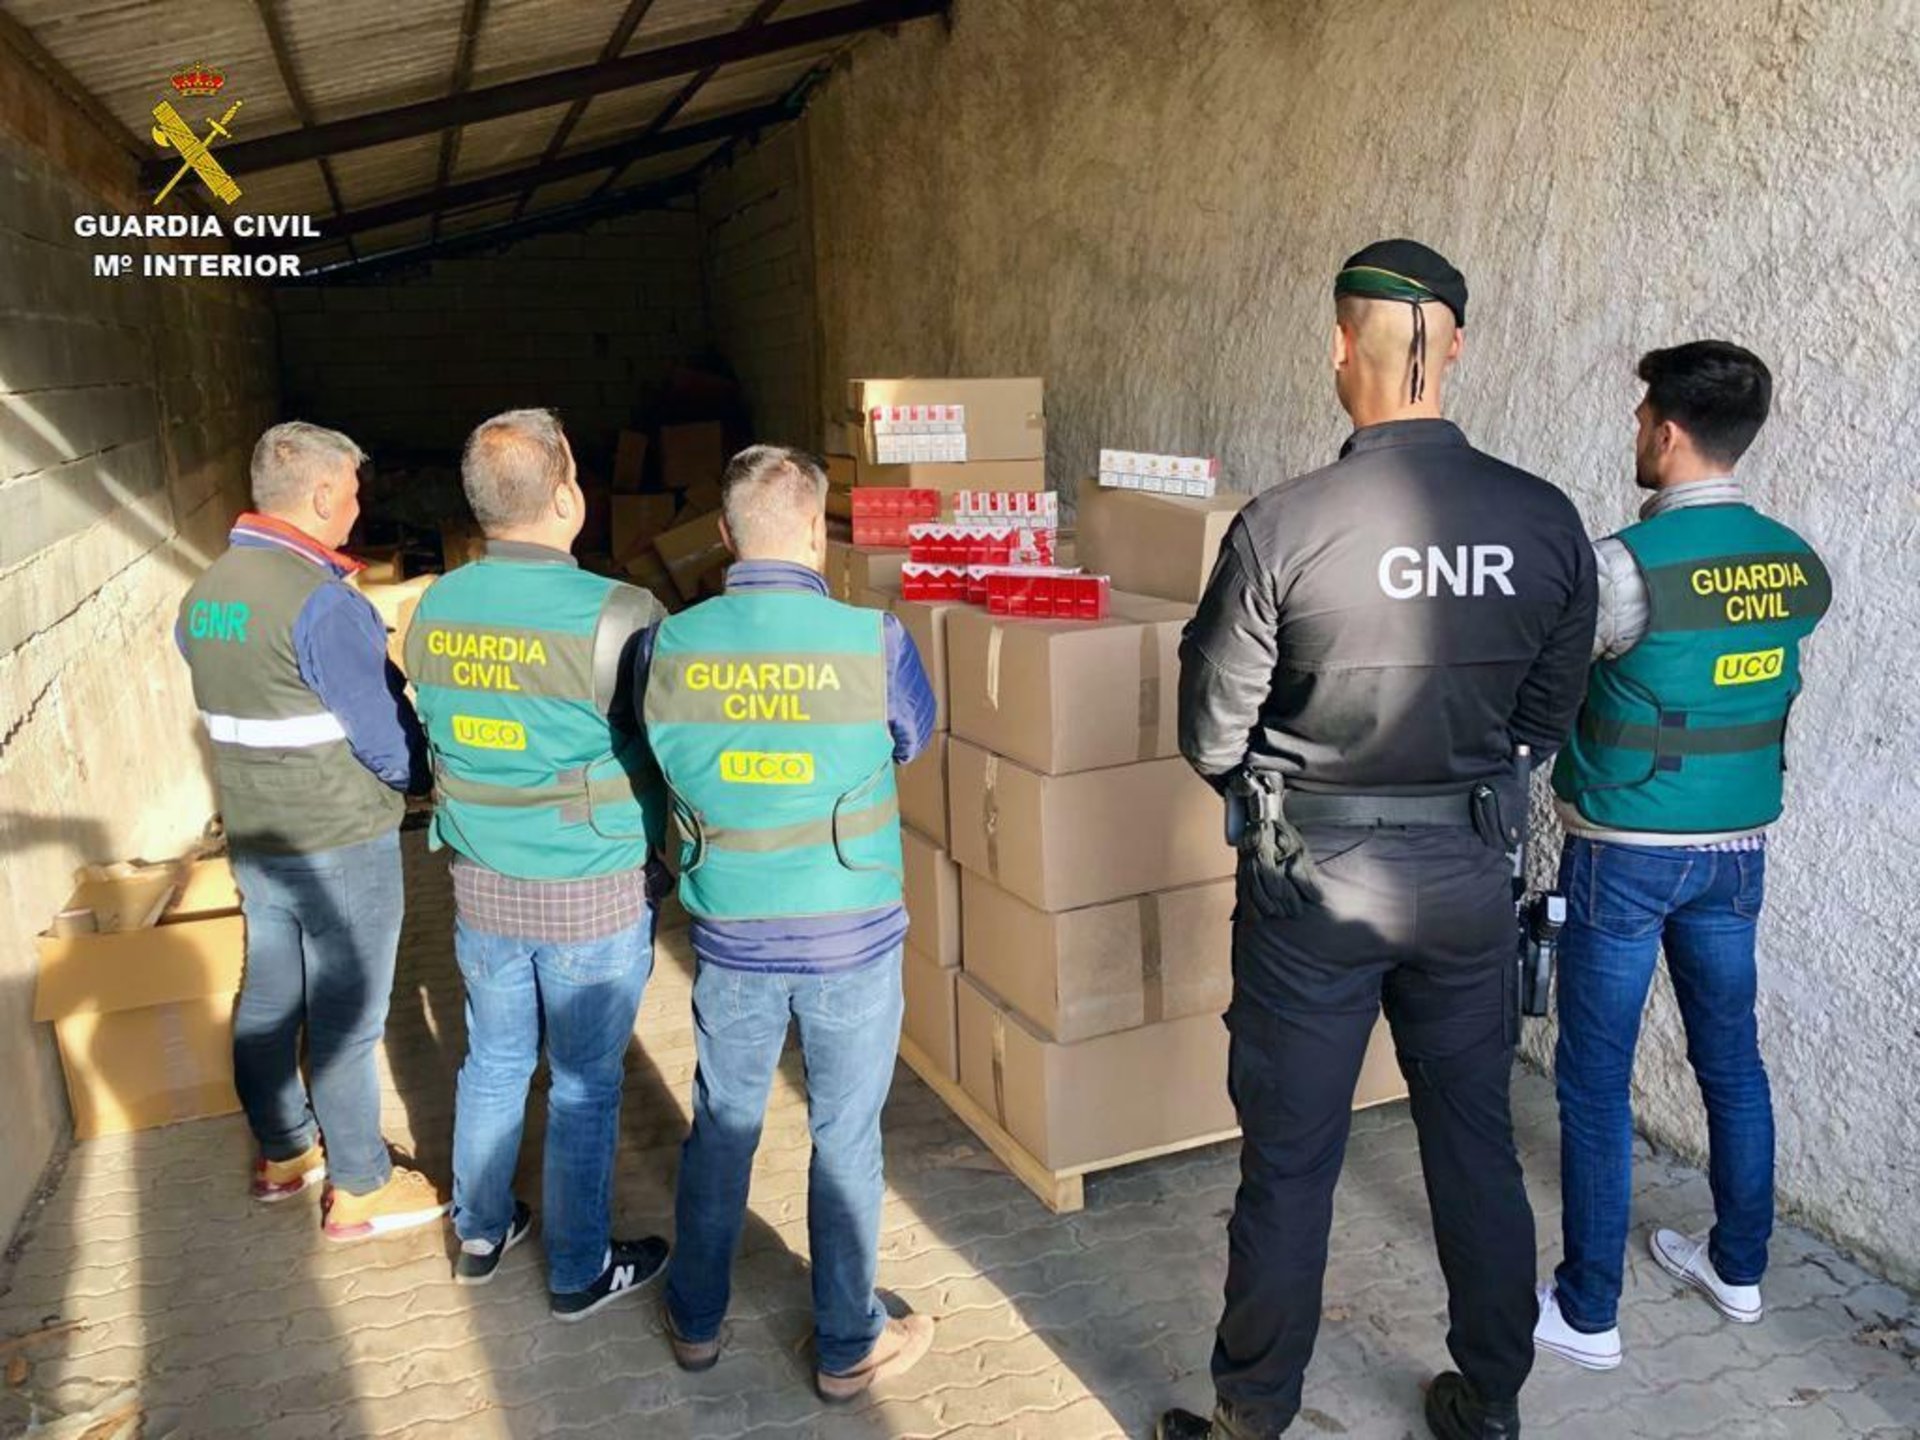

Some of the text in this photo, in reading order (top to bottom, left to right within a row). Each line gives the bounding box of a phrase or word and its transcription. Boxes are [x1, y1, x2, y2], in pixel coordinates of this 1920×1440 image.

[1378, 544, 1516, 599] GNR
[1691, 562, 1808, 596] GUARDIA
[189, 599, 251, 643] GNR
[1724, 591, 1790, 623] CIVIL
[427, 629, 547, 666] GUARDIA
[452, 660, 521, 691] CIVIL
[684, 662, 842, 691] GUARDIA
[1721, 651, 1782, 681] UCO
[723, 693, 811, 721] CIVIL
[458, 719, 521, 745] UCO
[727, 754, 806, 779] UCO
[609, 1265, 634, 1291] N
